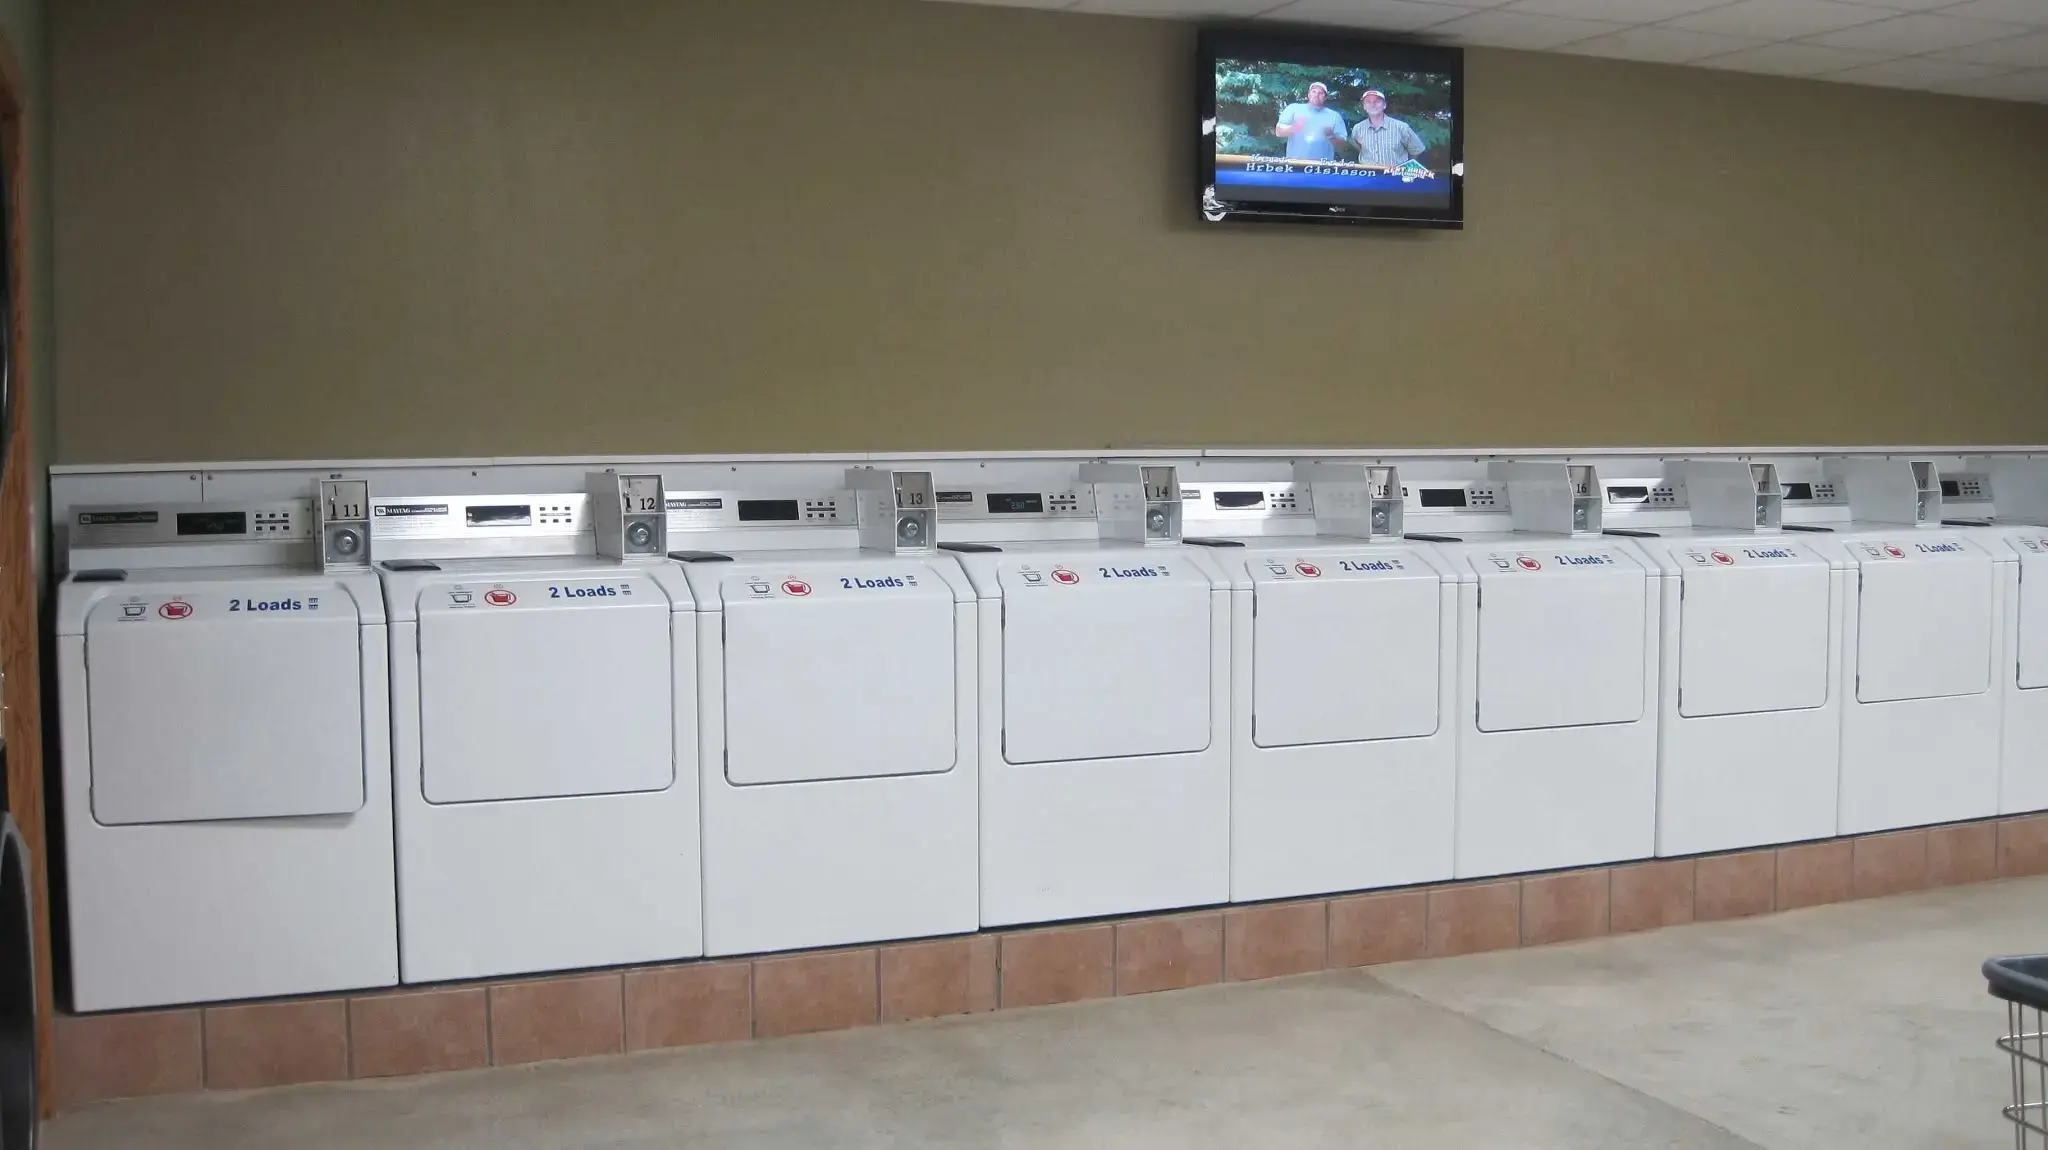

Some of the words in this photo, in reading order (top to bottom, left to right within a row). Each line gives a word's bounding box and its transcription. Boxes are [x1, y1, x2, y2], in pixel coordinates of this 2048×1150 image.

[1246, 162, 1294, 173] Hrbek
[1303, 165, 1377, 177] Gislason
[1155, 486, 1169, 498] 14
[1377, 484, 1389, 496] 15
[1576, 483, 1587, 494] 16
[640, 497, 656, 511] 12
[909, 493, 923, 505] 13
[343, 504, 360, 517] 11
[1743, 549, 1754, 559] 2
[1756, 548, 1788, 559] Loads
[1915, 544, 1927, 553] 2
[1929, 543, 1957, 553] Loads
[1339, 560, 1352, 571] 2
[1355, 559, 1393, 571] Loads
[1554, 555, 1566, 566] 2
[1568, 554, 1603, 566] Loads
[1099, 567, 1111, 578] 2
[1113, 565, 1157, 578] Loads
[840, 577, 852, 589] 2
[855, 576, 904, 589] Loads
[548, 586, 560, 599] 2
[564, 585, 617, 598] Loads
[229, 599, 240, 612] 2
[247, 598, 302, 611] Loads
